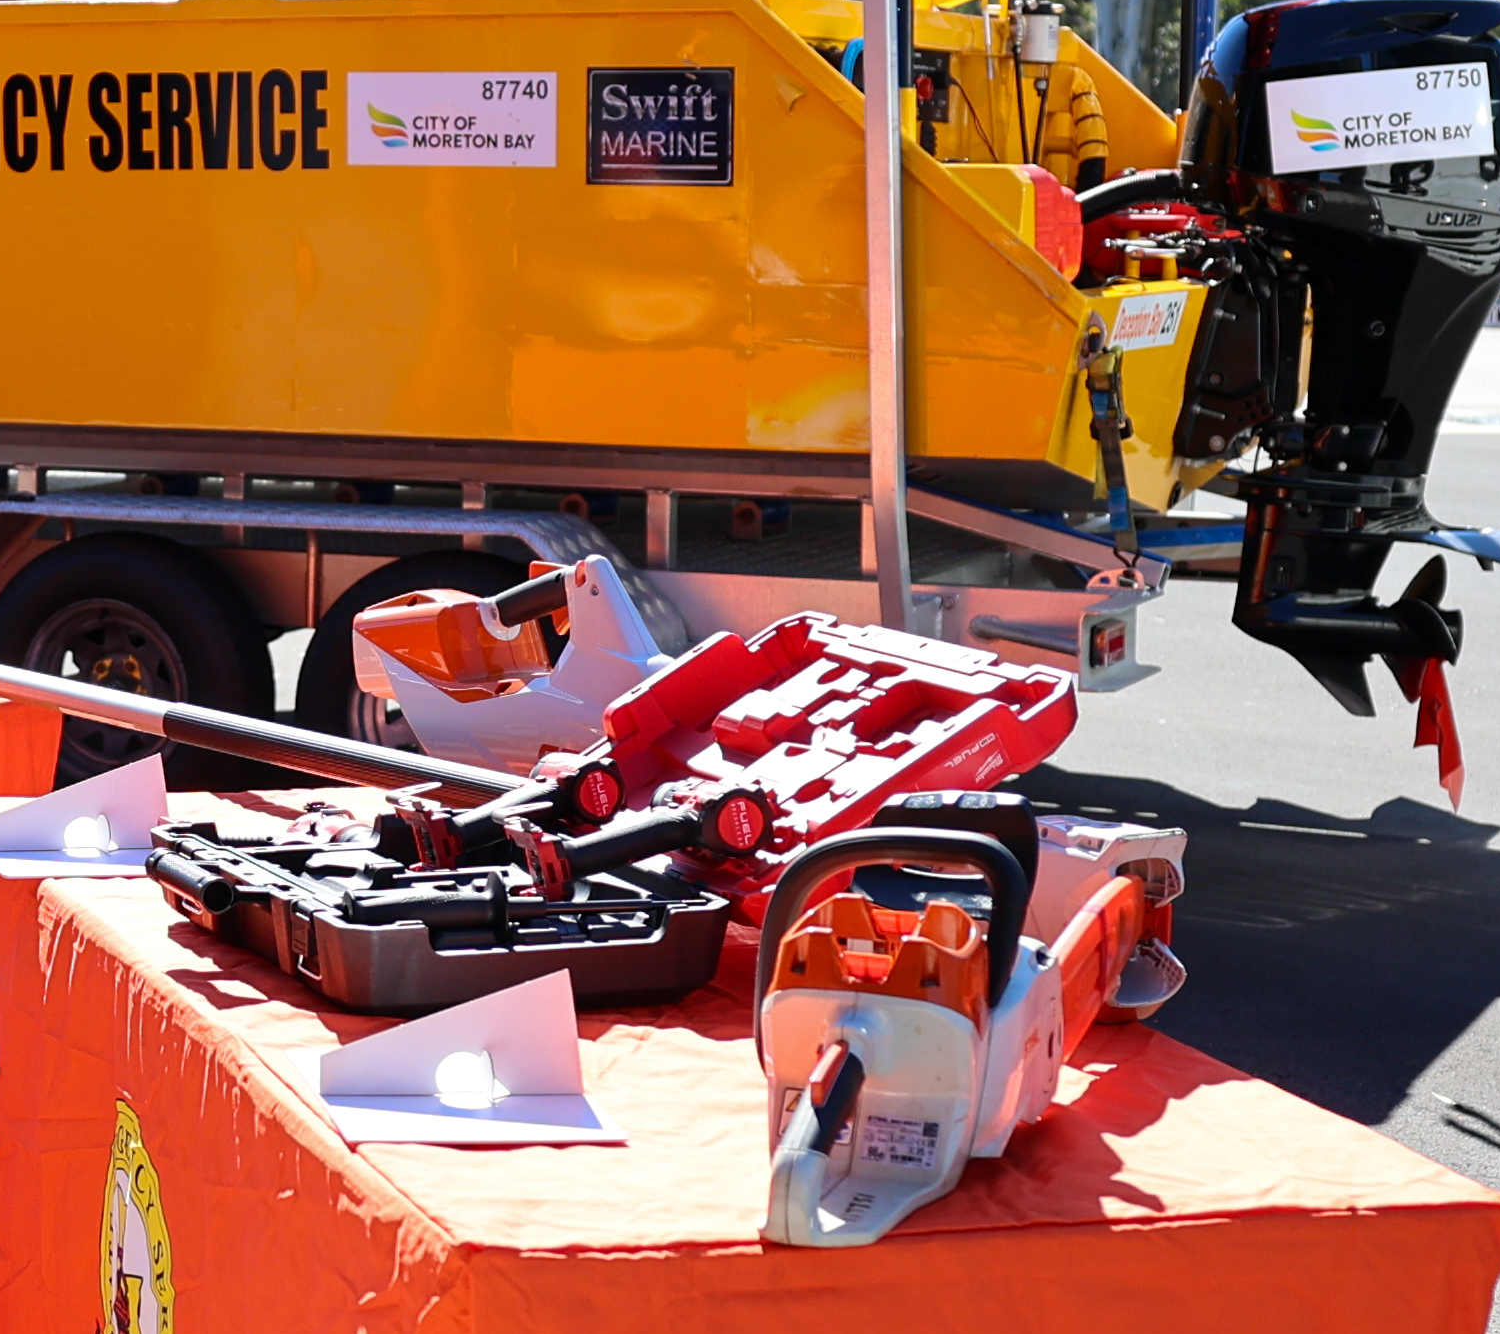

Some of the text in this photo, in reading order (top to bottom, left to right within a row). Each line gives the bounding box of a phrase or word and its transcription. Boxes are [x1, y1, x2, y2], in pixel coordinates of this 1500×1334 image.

[482, 79, 548, 100] 87740
[1416, 68, 1482, 91] 87750
[602, 83, 718, 122] Swift
[87, 68, 329, 173] SERVICE
[412, 115, 477, 131] CITY OF
[1343, 112, 1412, 131] CITY OF
[412, 133, 536, 149] MORETON BAY
[602, 131, 718, 157] MARINE
[1344, 124, 1472, 149] MORETON BAY
[1160, 300, 1183, 334] 251
[594, 772, 612, 815] FUEL
[736, 801, 752, 845] FUEL
